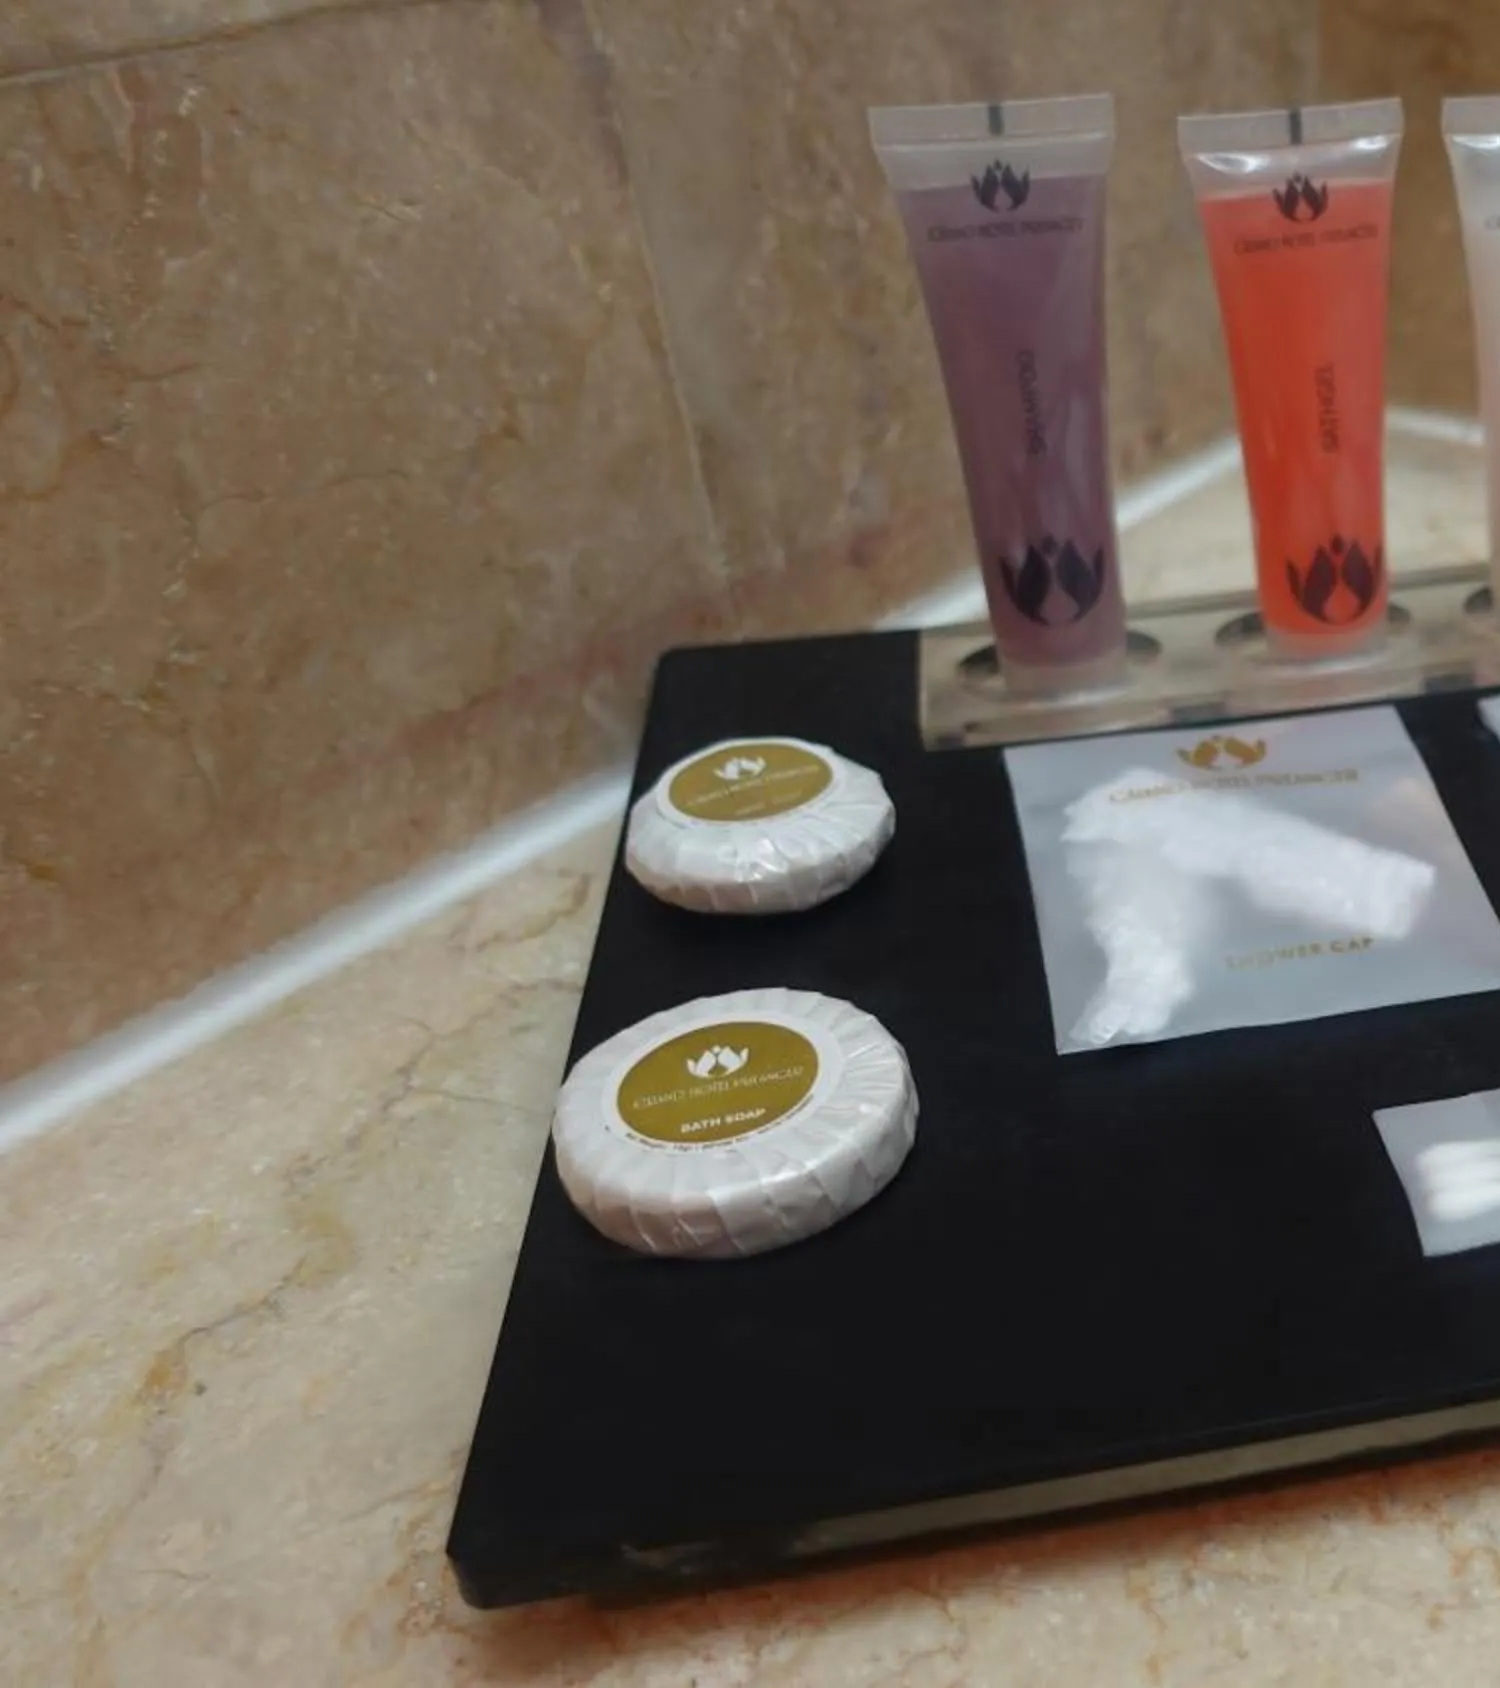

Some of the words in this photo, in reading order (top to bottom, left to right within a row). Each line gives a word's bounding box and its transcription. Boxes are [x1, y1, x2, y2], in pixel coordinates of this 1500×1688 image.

[1329, 935, 1375, 955] CAP
[680, 1116, 722, 1134] BATH
[724, 1107, 767, 1125] SOAP
